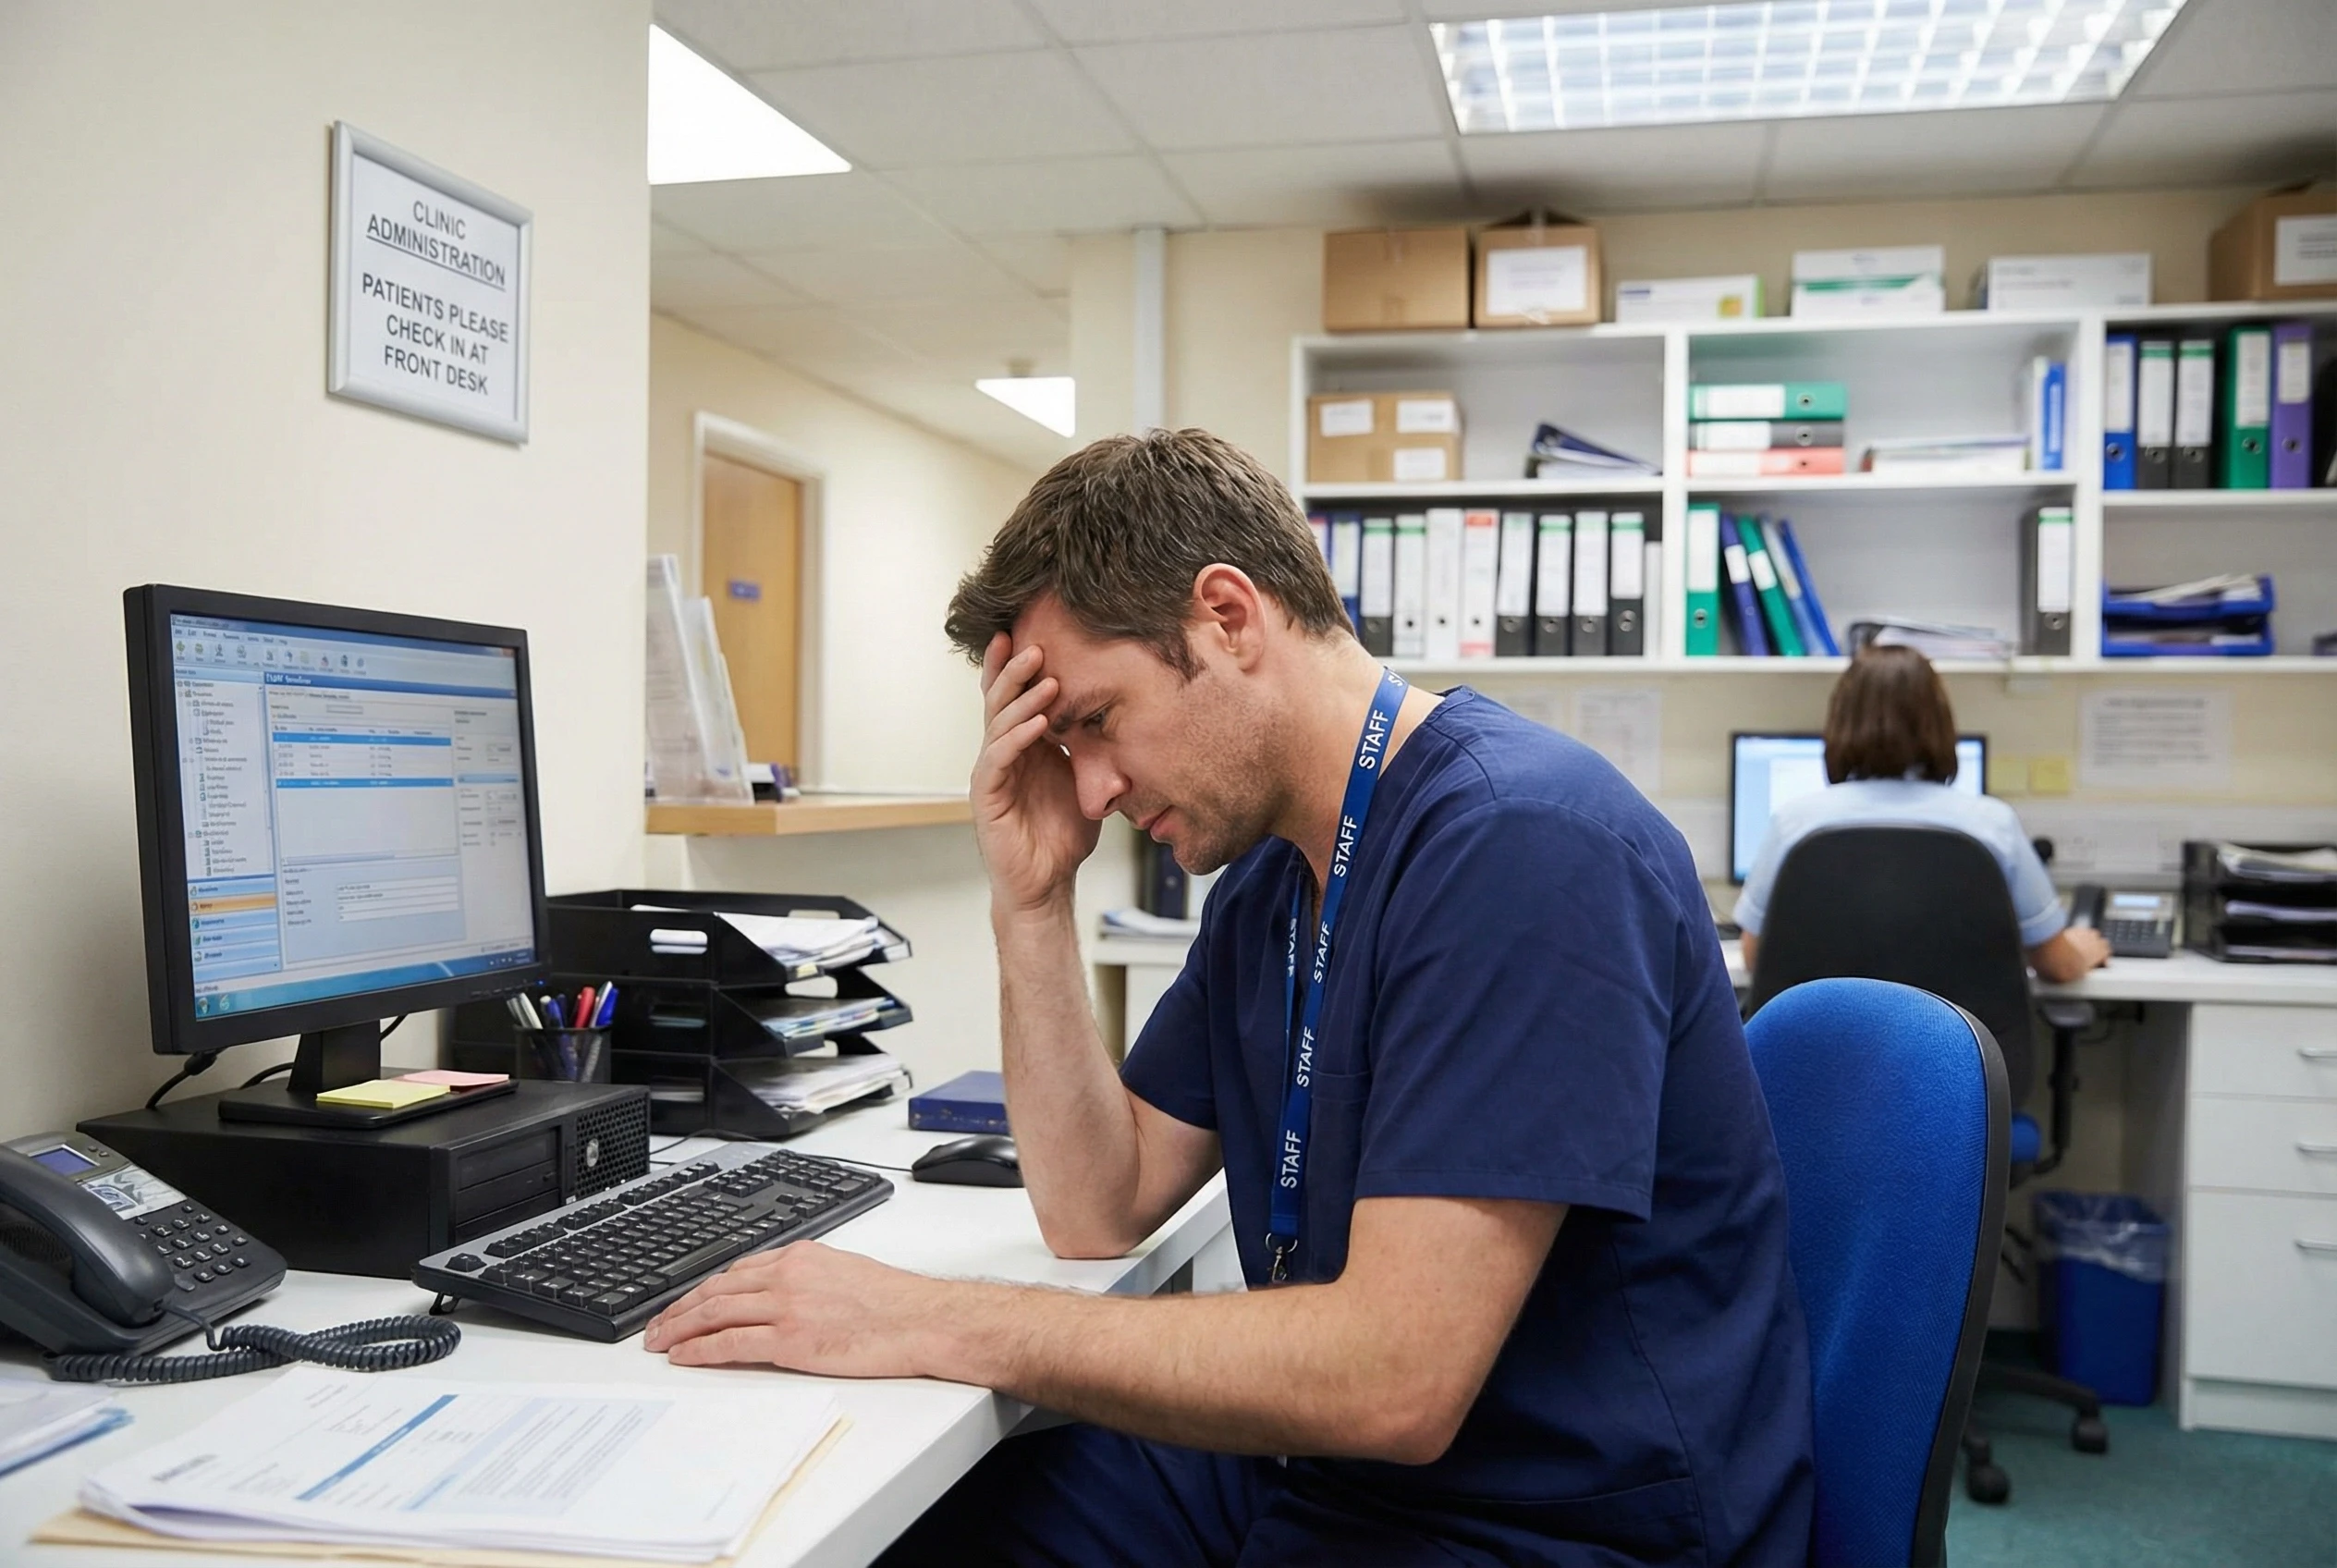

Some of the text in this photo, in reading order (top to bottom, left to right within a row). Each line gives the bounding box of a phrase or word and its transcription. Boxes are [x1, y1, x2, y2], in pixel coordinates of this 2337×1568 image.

[367, 213, 506, 287] ADMINISTRATION
[412, 200, 466, 240] CLINIC
[362, 272, 508, 344] PATIENTS PLEASE
[386, 313, 489, 366] CHECK IN AT
[385, 346, 488, 396] FRONT DESK
[1358, 709, 1389, 770] STAFF
[1333, 815, 1357, 877] STAFF
[1314, 921, 1330, 985] STAFF
[1296, 1025, 1315, 1088] STAFF
[1280, 1129, 1302, 1189] STAFF
